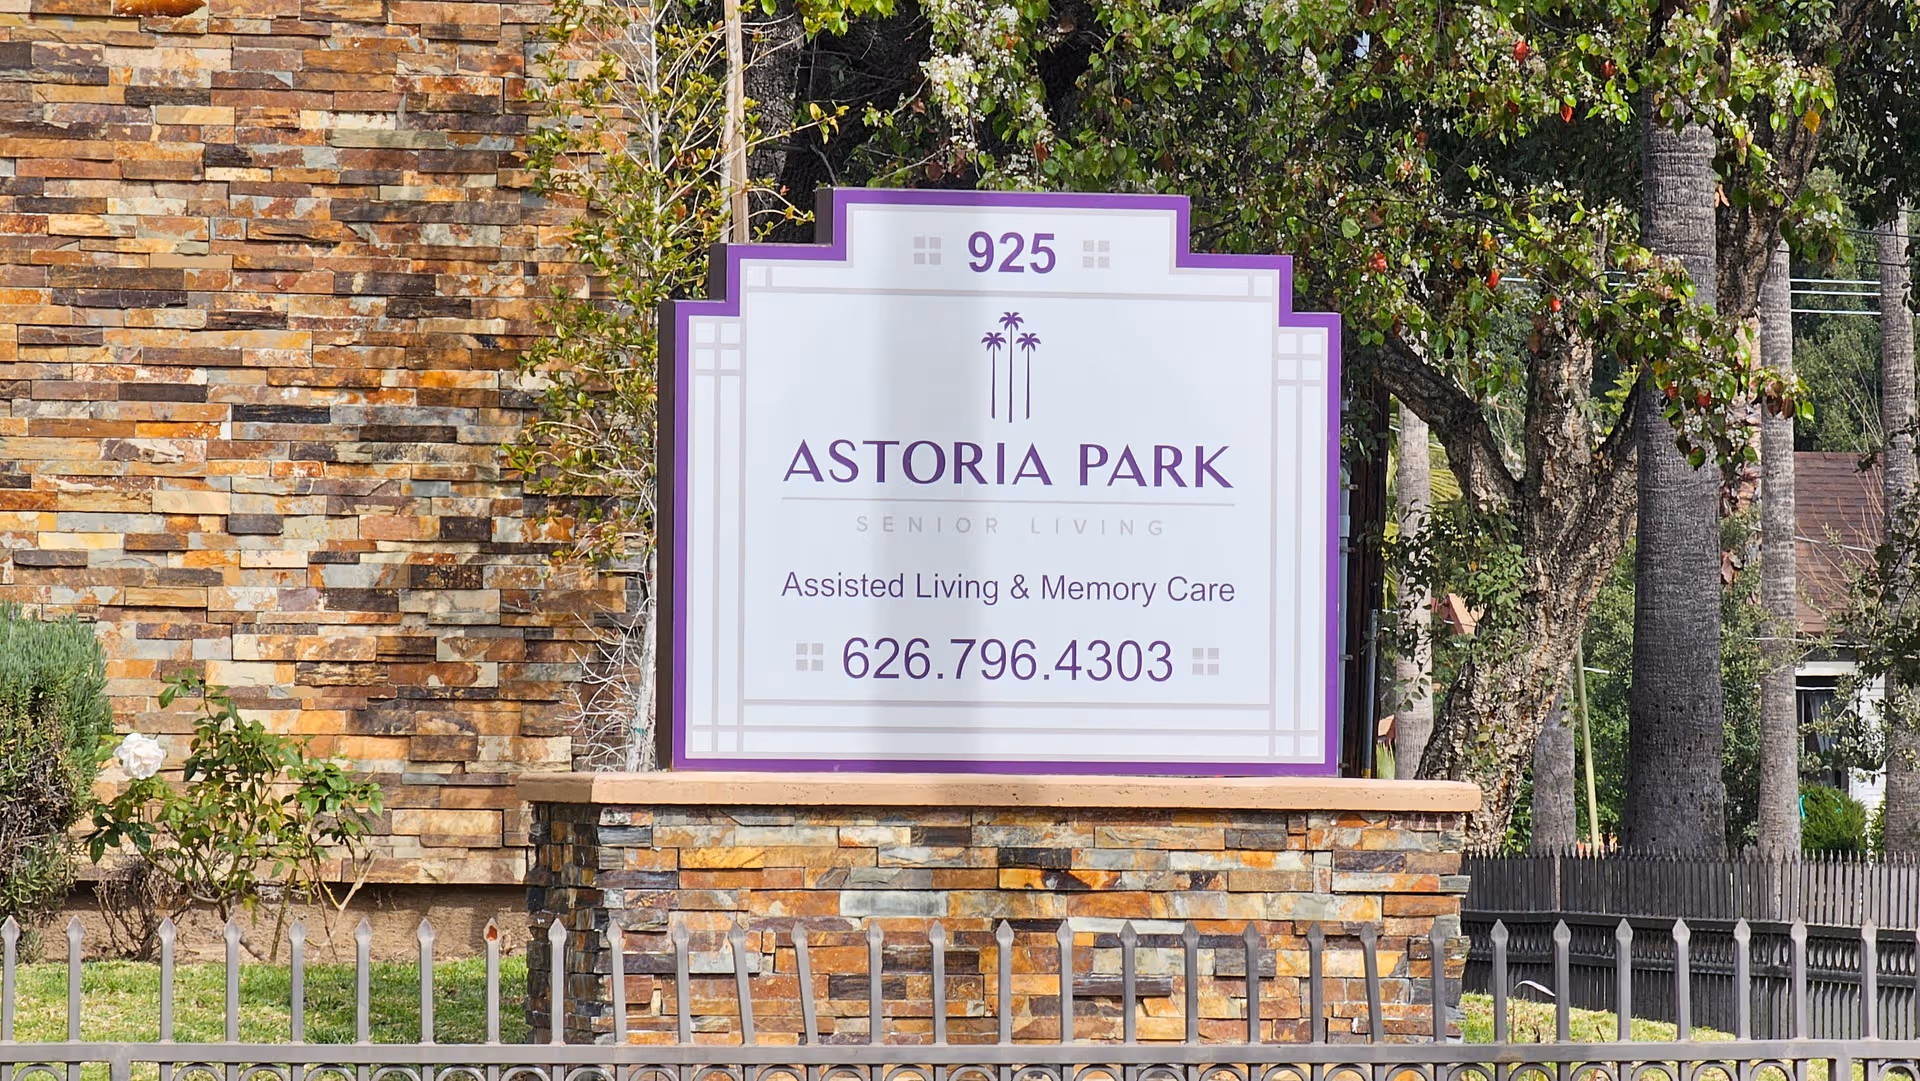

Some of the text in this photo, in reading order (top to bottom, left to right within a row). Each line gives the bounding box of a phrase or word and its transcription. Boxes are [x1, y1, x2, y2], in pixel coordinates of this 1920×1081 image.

[968, 230, 1057, 274] 925
[783, 439, 1233, 489] ASTORIA PARK
[856, 516, 1161, 536] SENIOR LIVING
[781, 571, 1235, 608] Assisted Living & Memory Care
[843, 636, 1173, 683] 626.796.4303
